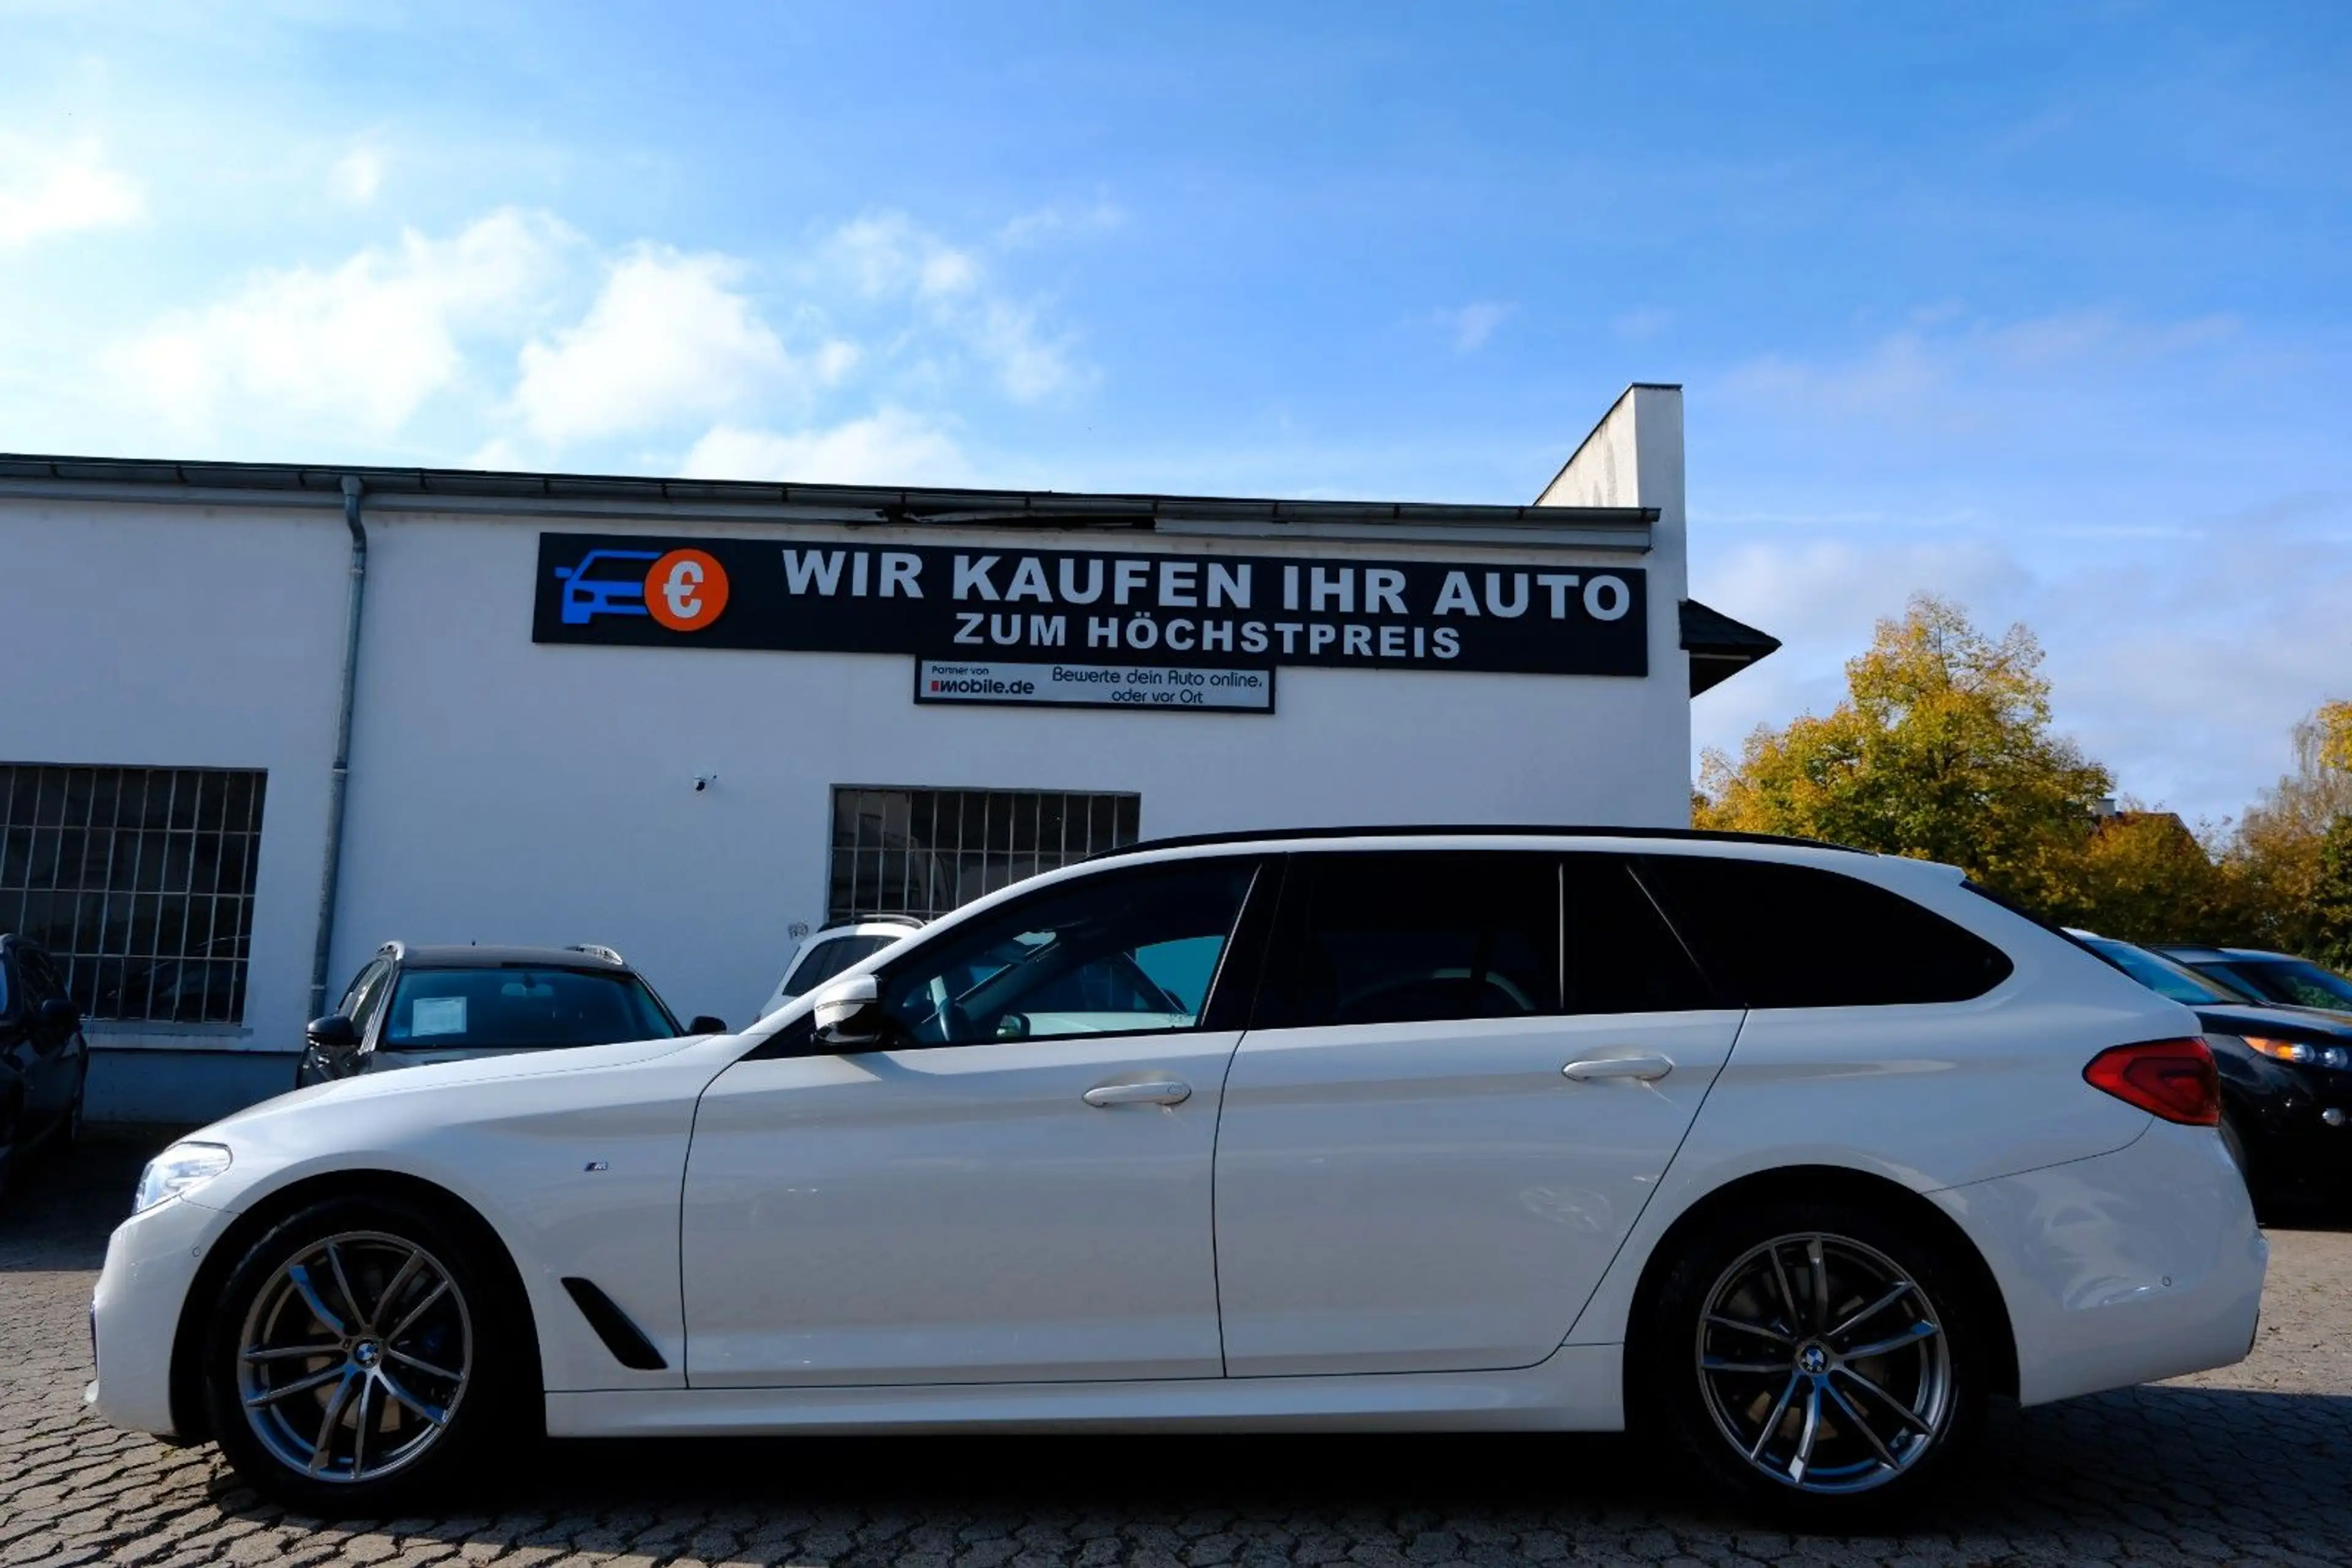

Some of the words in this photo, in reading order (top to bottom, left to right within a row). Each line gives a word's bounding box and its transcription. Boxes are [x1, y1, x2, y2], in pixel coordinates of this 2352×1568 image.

[782, 549, 924, 598] WIR
[952, 555, 1251, 608] KAUFEN
[1284, 565, 1408, 614] IHR
[1433, 571, 1630, 621] AUTO
[954, 612, 1066, 646] ZUM
[1088, 610, 1460, 659] HÖCHSTPREIS
[932, 665, 968, 674] Partner
[1052, 666, 1120, 683] Bewerte
[1126, 668, 1163, 684] dein
[1168, 670, 1205, 686] Auto
[941, 679, 1035, 695] mobile.de
[1111, 688, 1147, 702] oder
[1152, 692, 1175, 703] vor
[1180, 688, 1203, 703] Ort
